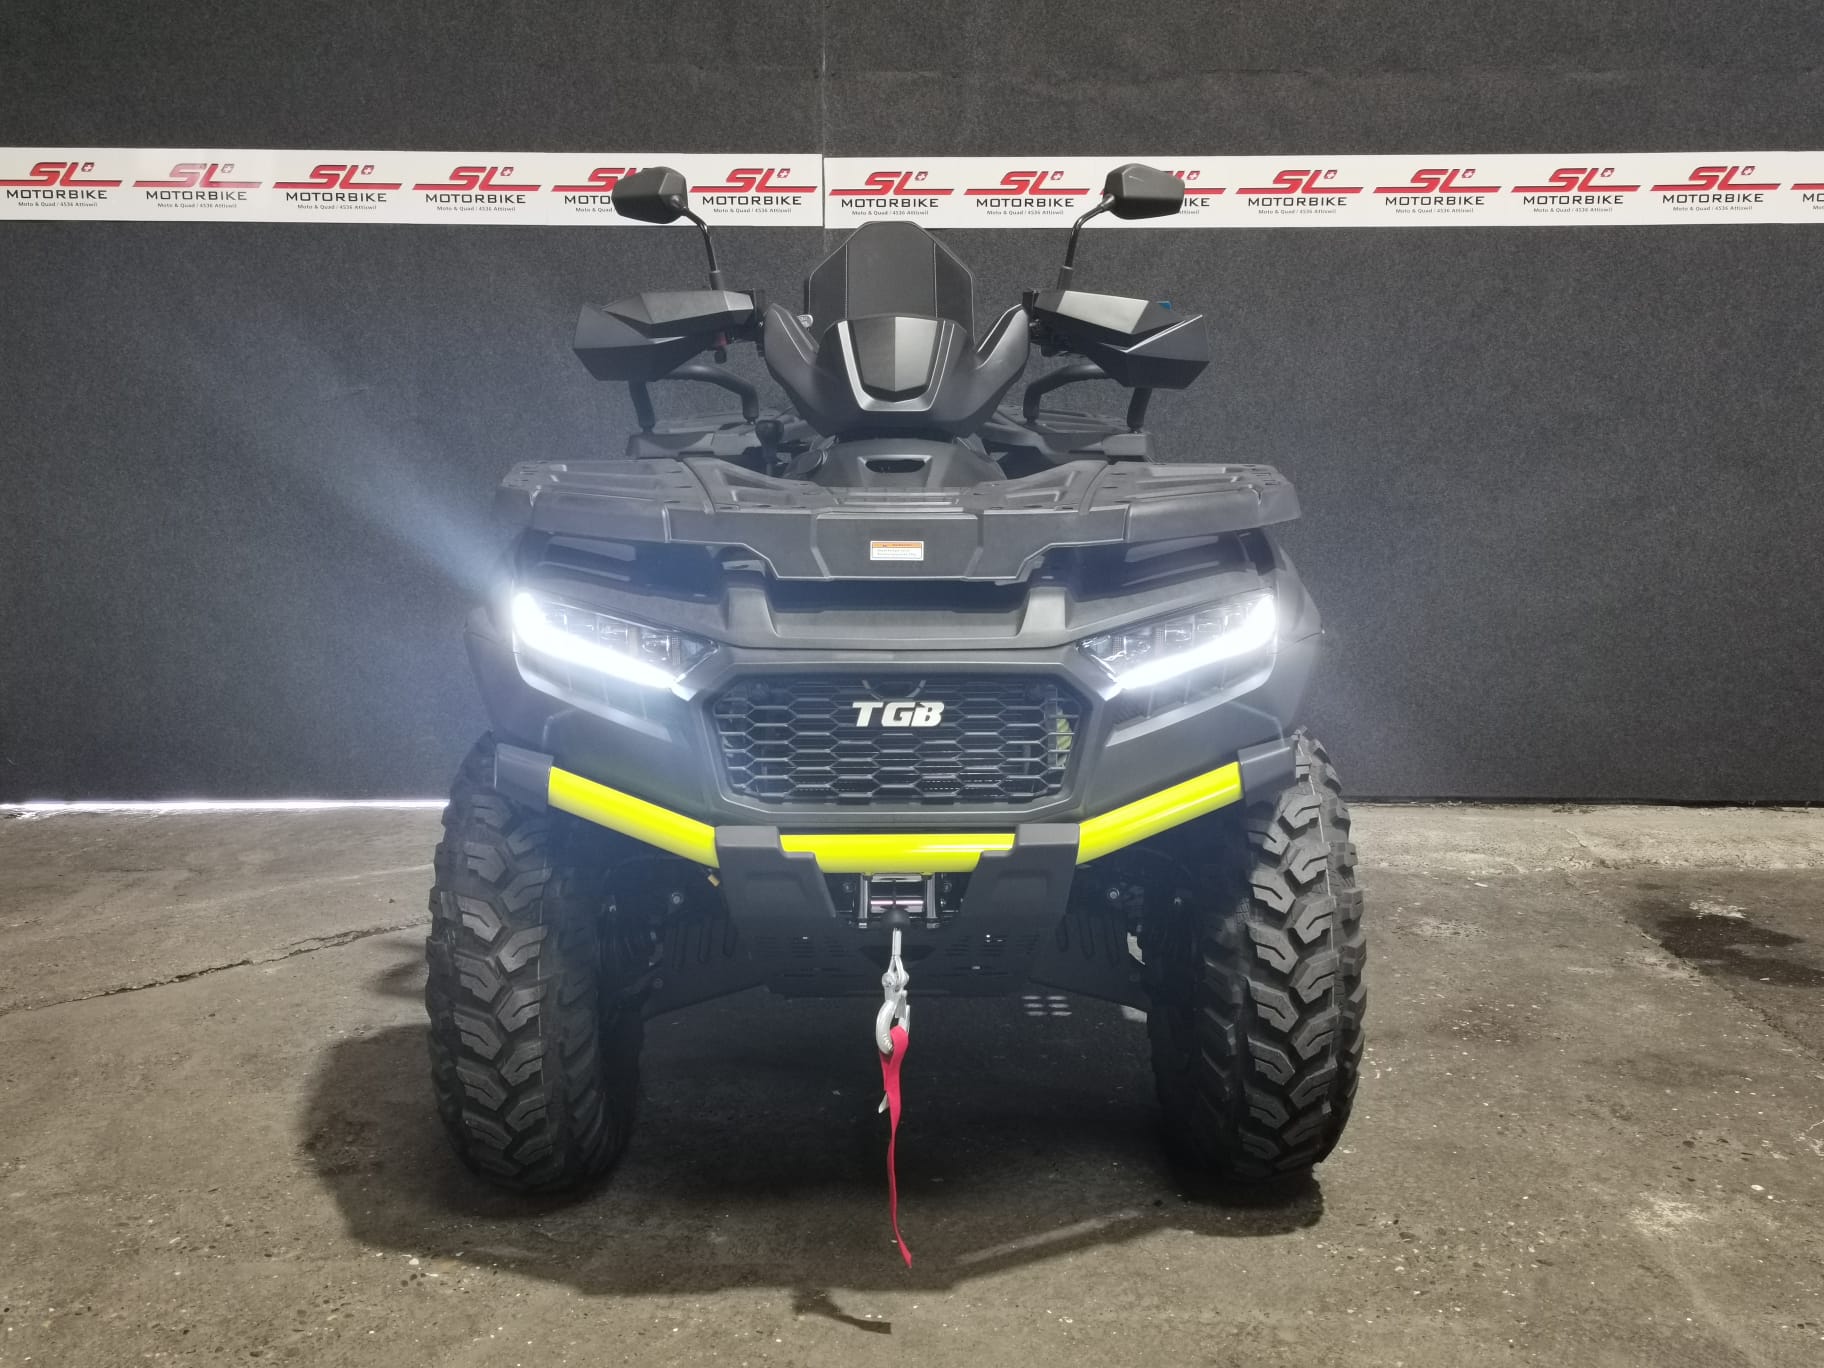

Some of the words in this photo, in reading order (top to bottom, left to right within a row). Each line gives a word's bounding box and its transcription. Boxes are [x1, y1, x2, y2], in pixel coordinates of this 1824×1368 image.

[7, 190, 107, 199] MOTORBIKE
[146, 191, 247, 200] MOTORBIKE
[286, 192, 387, 202] MOTORBIKE
[426, 194, 526, 203] MOTORBIKE
[1663, 194, 1764, 203] MOTORBIKE
[703, 196, 801, 205] MOTORBIKE
[842, 199, 939, 208] MOTORBIKE
[977, 198, 1074, 207] MOTORBIKE
[1248, 197, 1347, 206] MOTORBIKE
[1386, 196, 1485, 205] MOTORBIKE
[1524, 195, 1624, 205] MOTORBIKE
[852, 701, 944, 728] TGB
